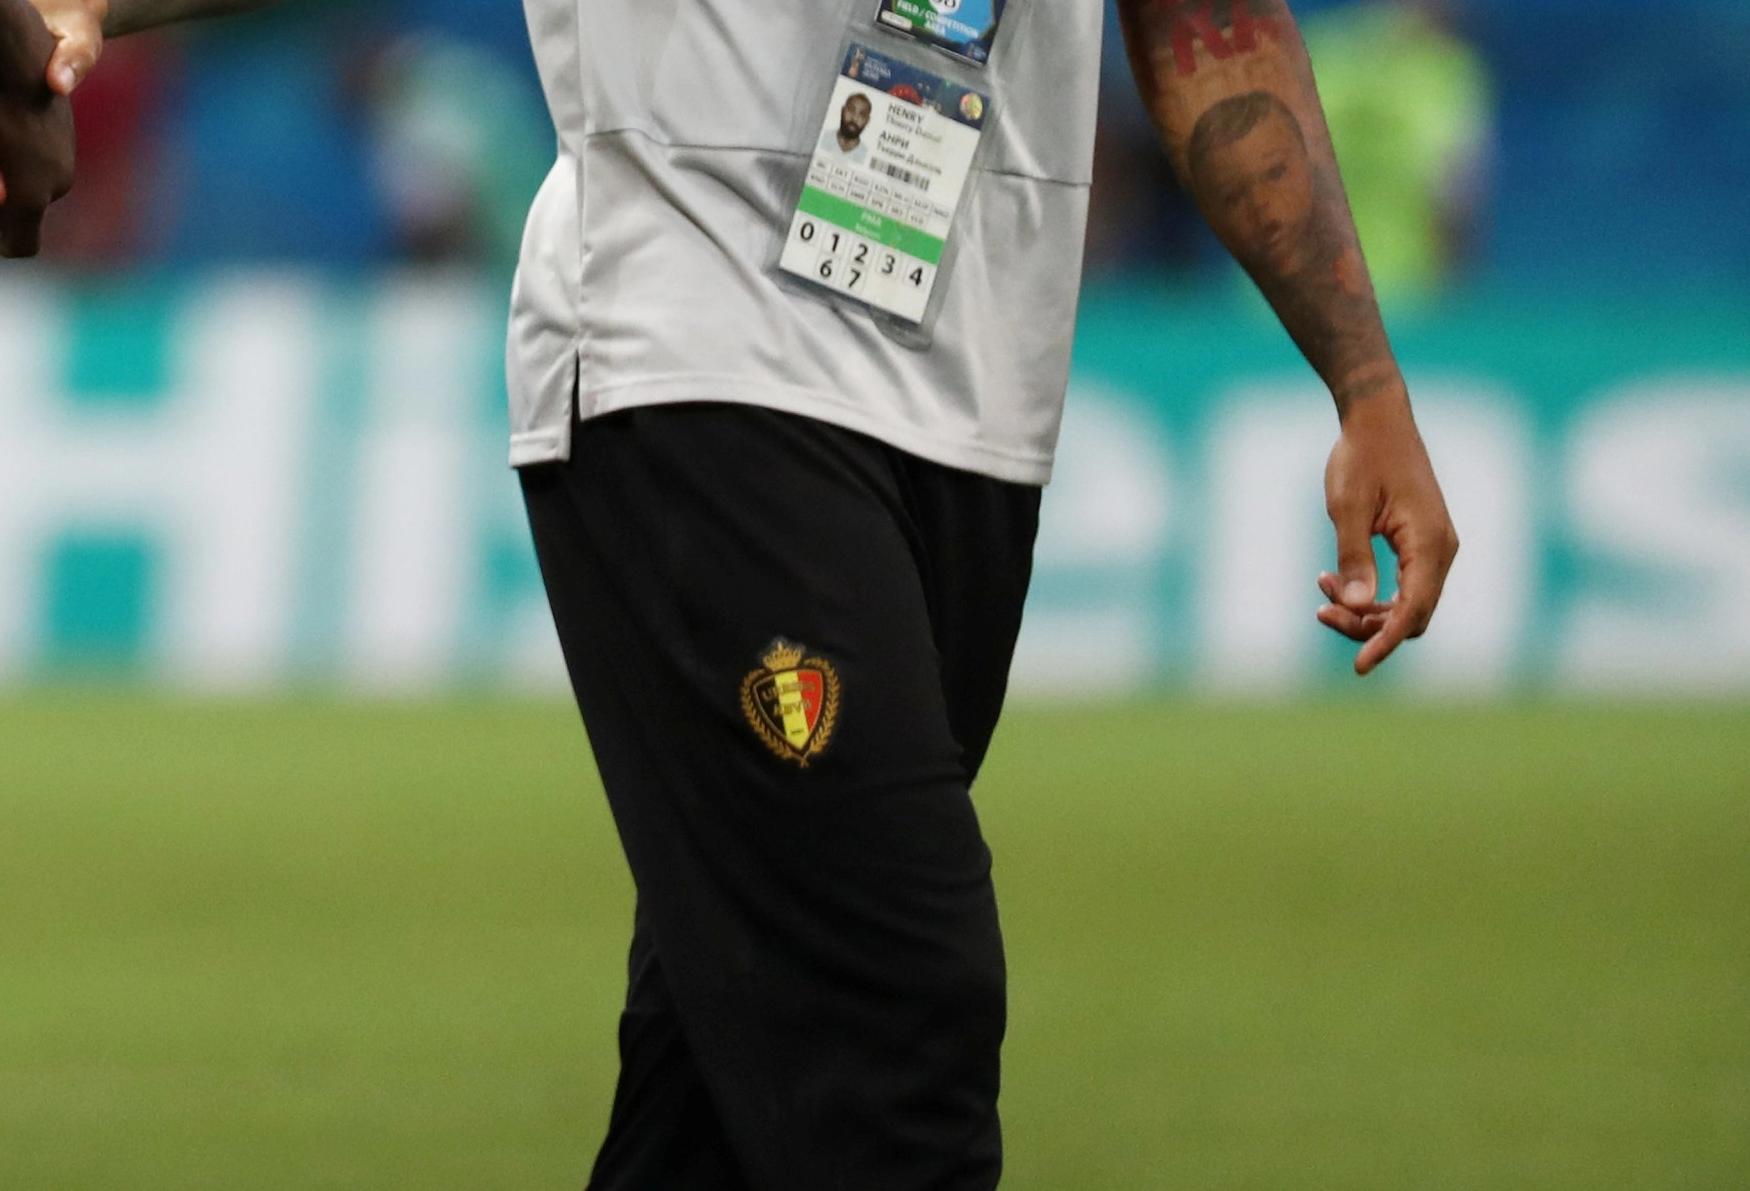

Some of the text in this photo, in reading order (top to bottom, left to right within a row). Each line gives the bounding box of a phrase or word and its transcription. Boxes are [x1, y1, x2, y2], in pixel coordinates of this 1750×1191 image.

[889, 102, 923, 123] HENRY
[800, 222, 923, 286] 0 1 2 3 4
[820, 260, 861, 288] 6 7
